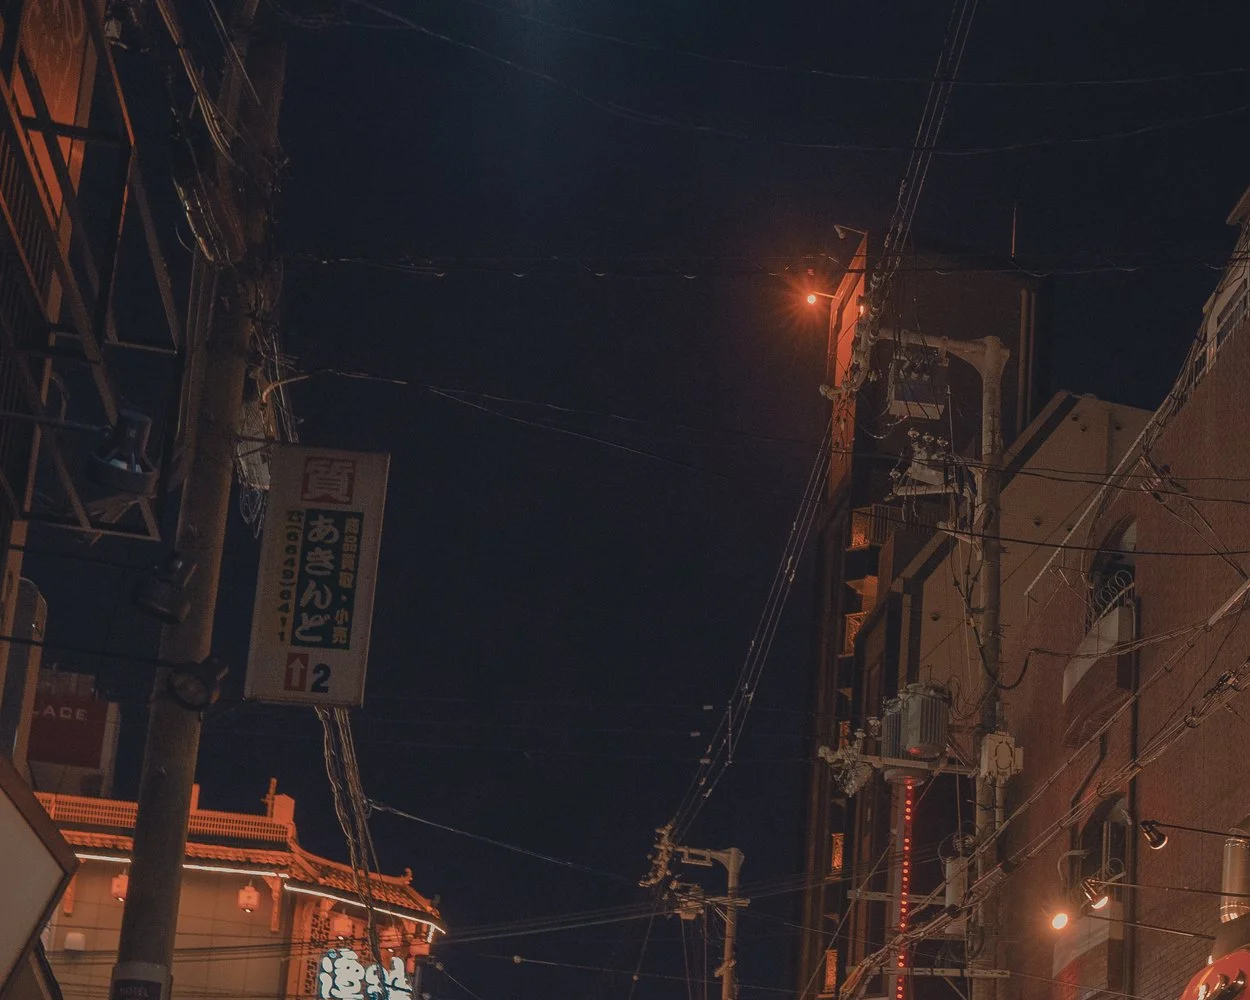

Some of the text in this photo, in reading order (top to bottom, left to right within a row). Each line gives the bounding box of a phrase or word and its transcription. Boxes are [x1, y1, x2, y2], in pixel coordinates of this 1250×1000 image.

[294, 514, 340, 643] あきんど
[311, 663, 331, 693] 2
